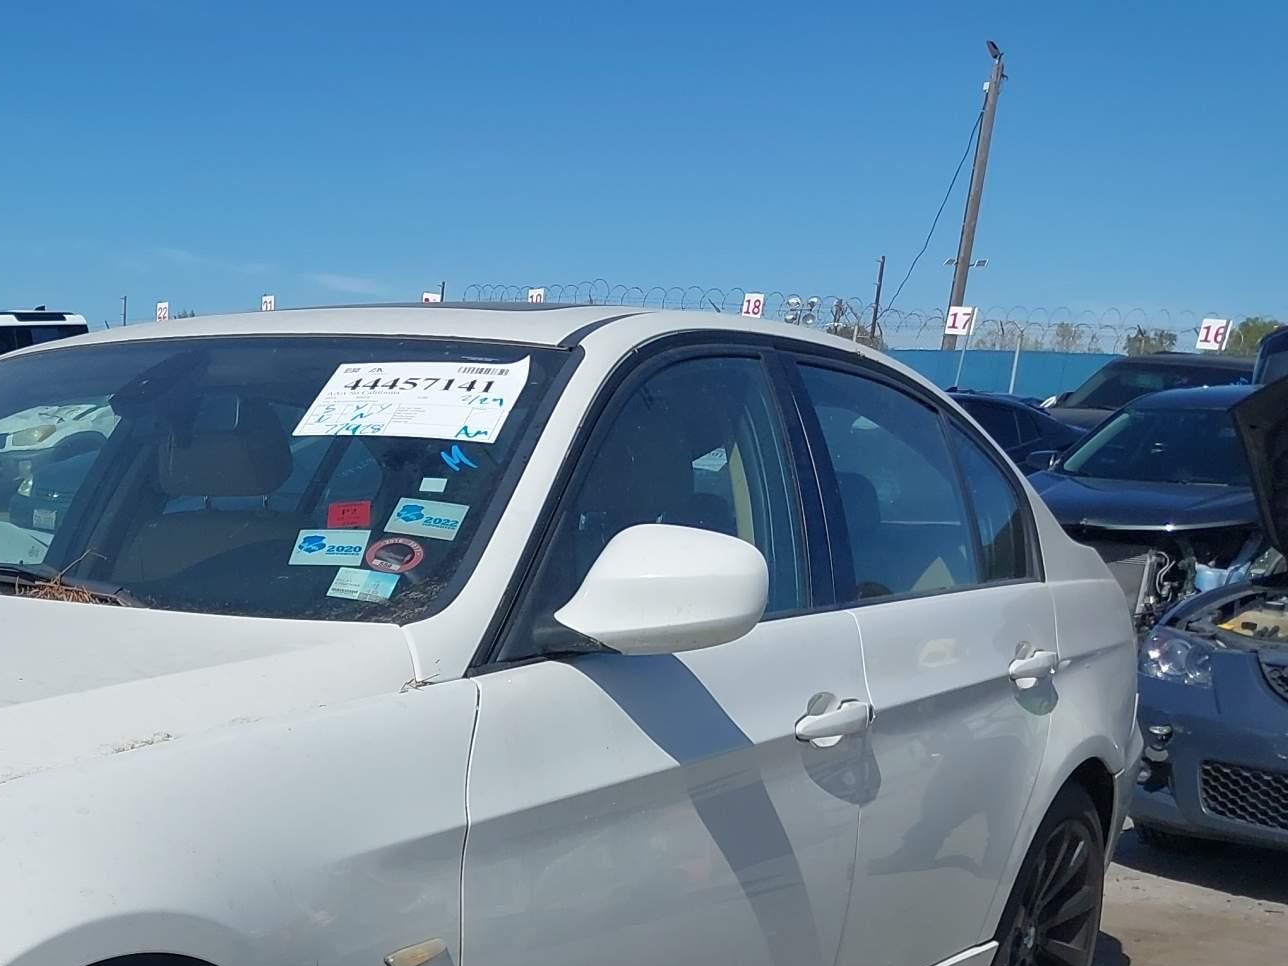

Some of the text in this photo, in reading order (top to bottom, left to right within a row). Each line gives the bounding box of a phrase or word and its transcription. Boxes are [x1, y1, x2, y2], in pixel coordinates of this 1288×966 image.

[157, 306, 168, 320] 22
[743, 299, 761, 315] 18
[947, 312, 972, 330] 17
[1199, 325, 1226, 344] 16
[343, 377, 495, 393] 44457141
[423, 516, 460, 528] 2022
[326, 545, 363, 554] 2020
